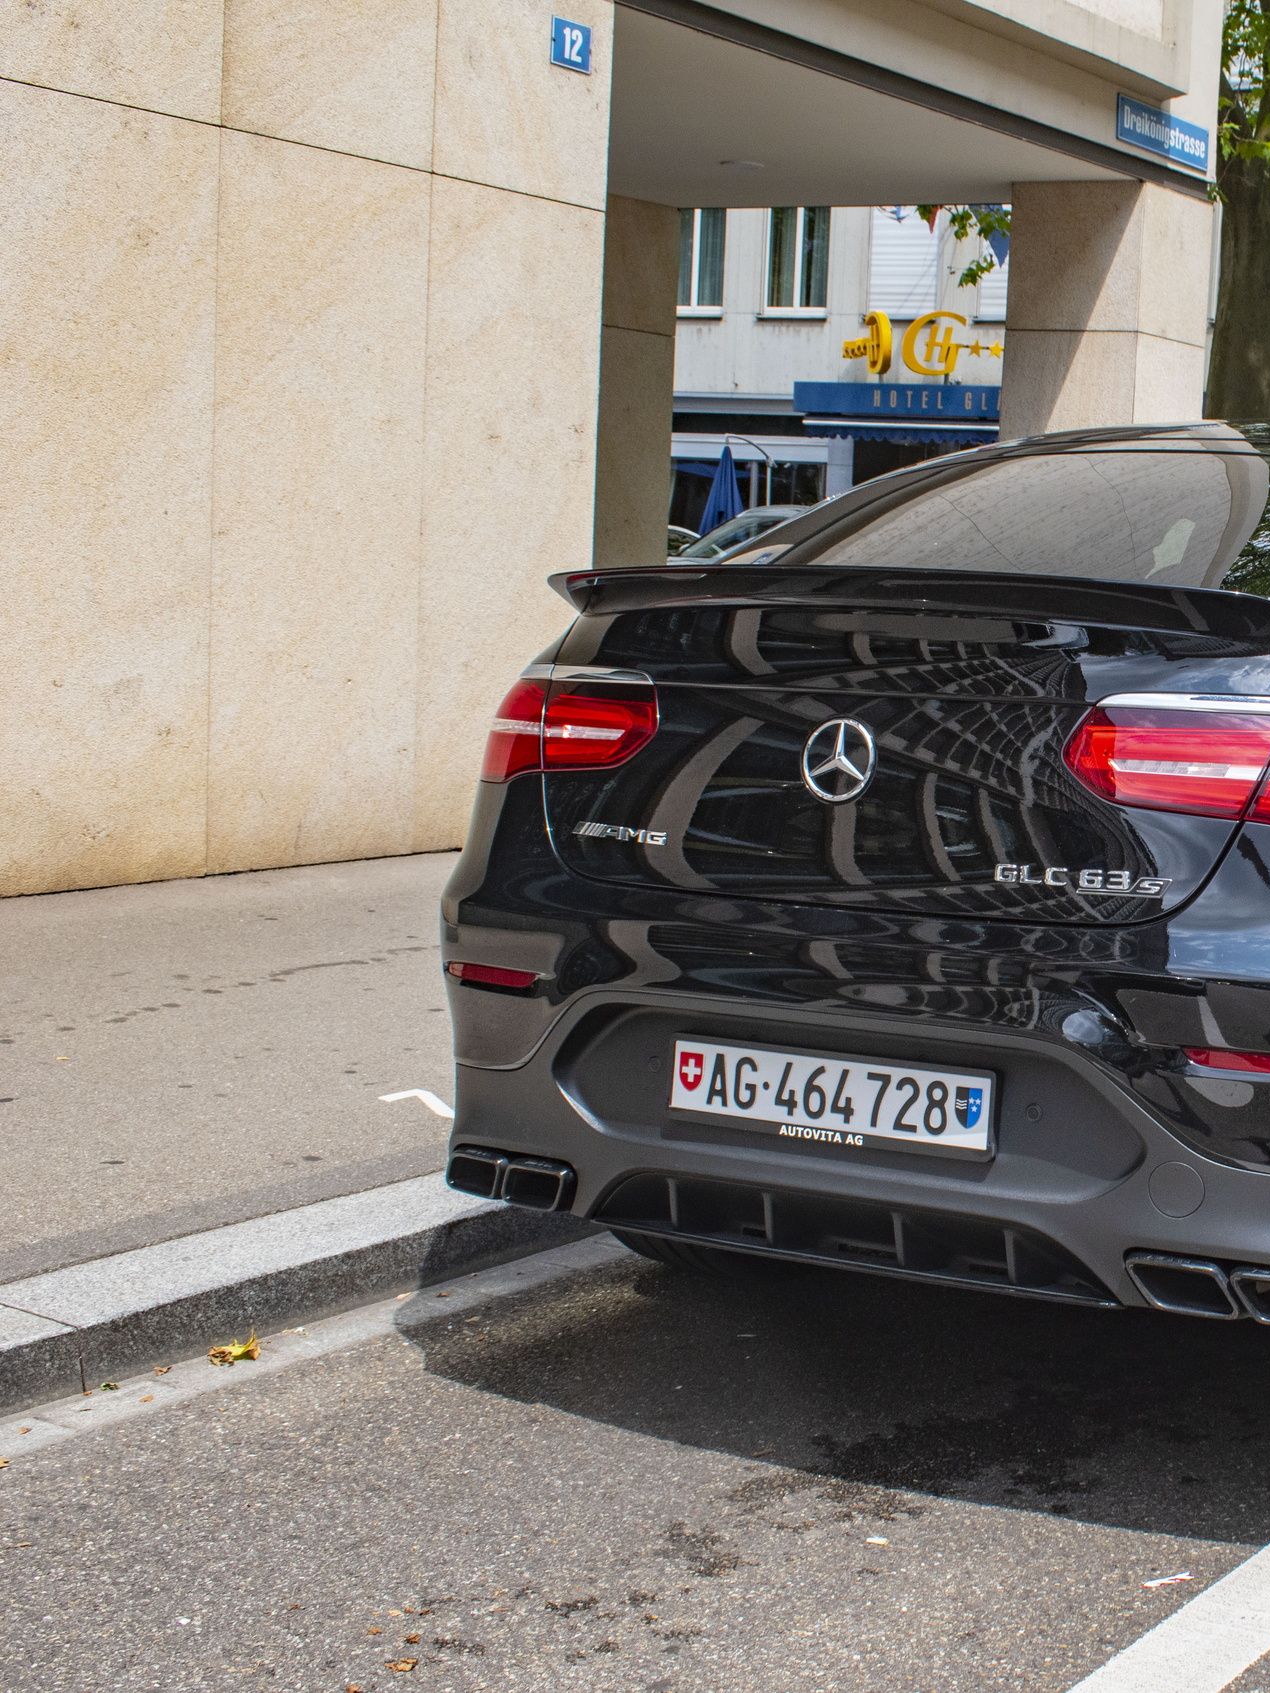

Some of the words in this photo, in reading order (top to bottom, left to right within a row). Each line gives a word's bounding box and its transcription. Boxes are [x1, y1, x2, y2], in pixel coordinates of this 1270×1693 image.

[563, 26, 583, 63] 12
[1123, 105, 1206, 159] Dreikönigstrasse
[873, 389, 943, 410] HOTEL
[602, 823, 668, 847] AMG
[994, 863, 1069, 887] GLC
[1079, 868, 1131, 891] 63
[779, 1124, 843, 1144] AUTOVITA
[845, 1133, 864, 1147] AG
